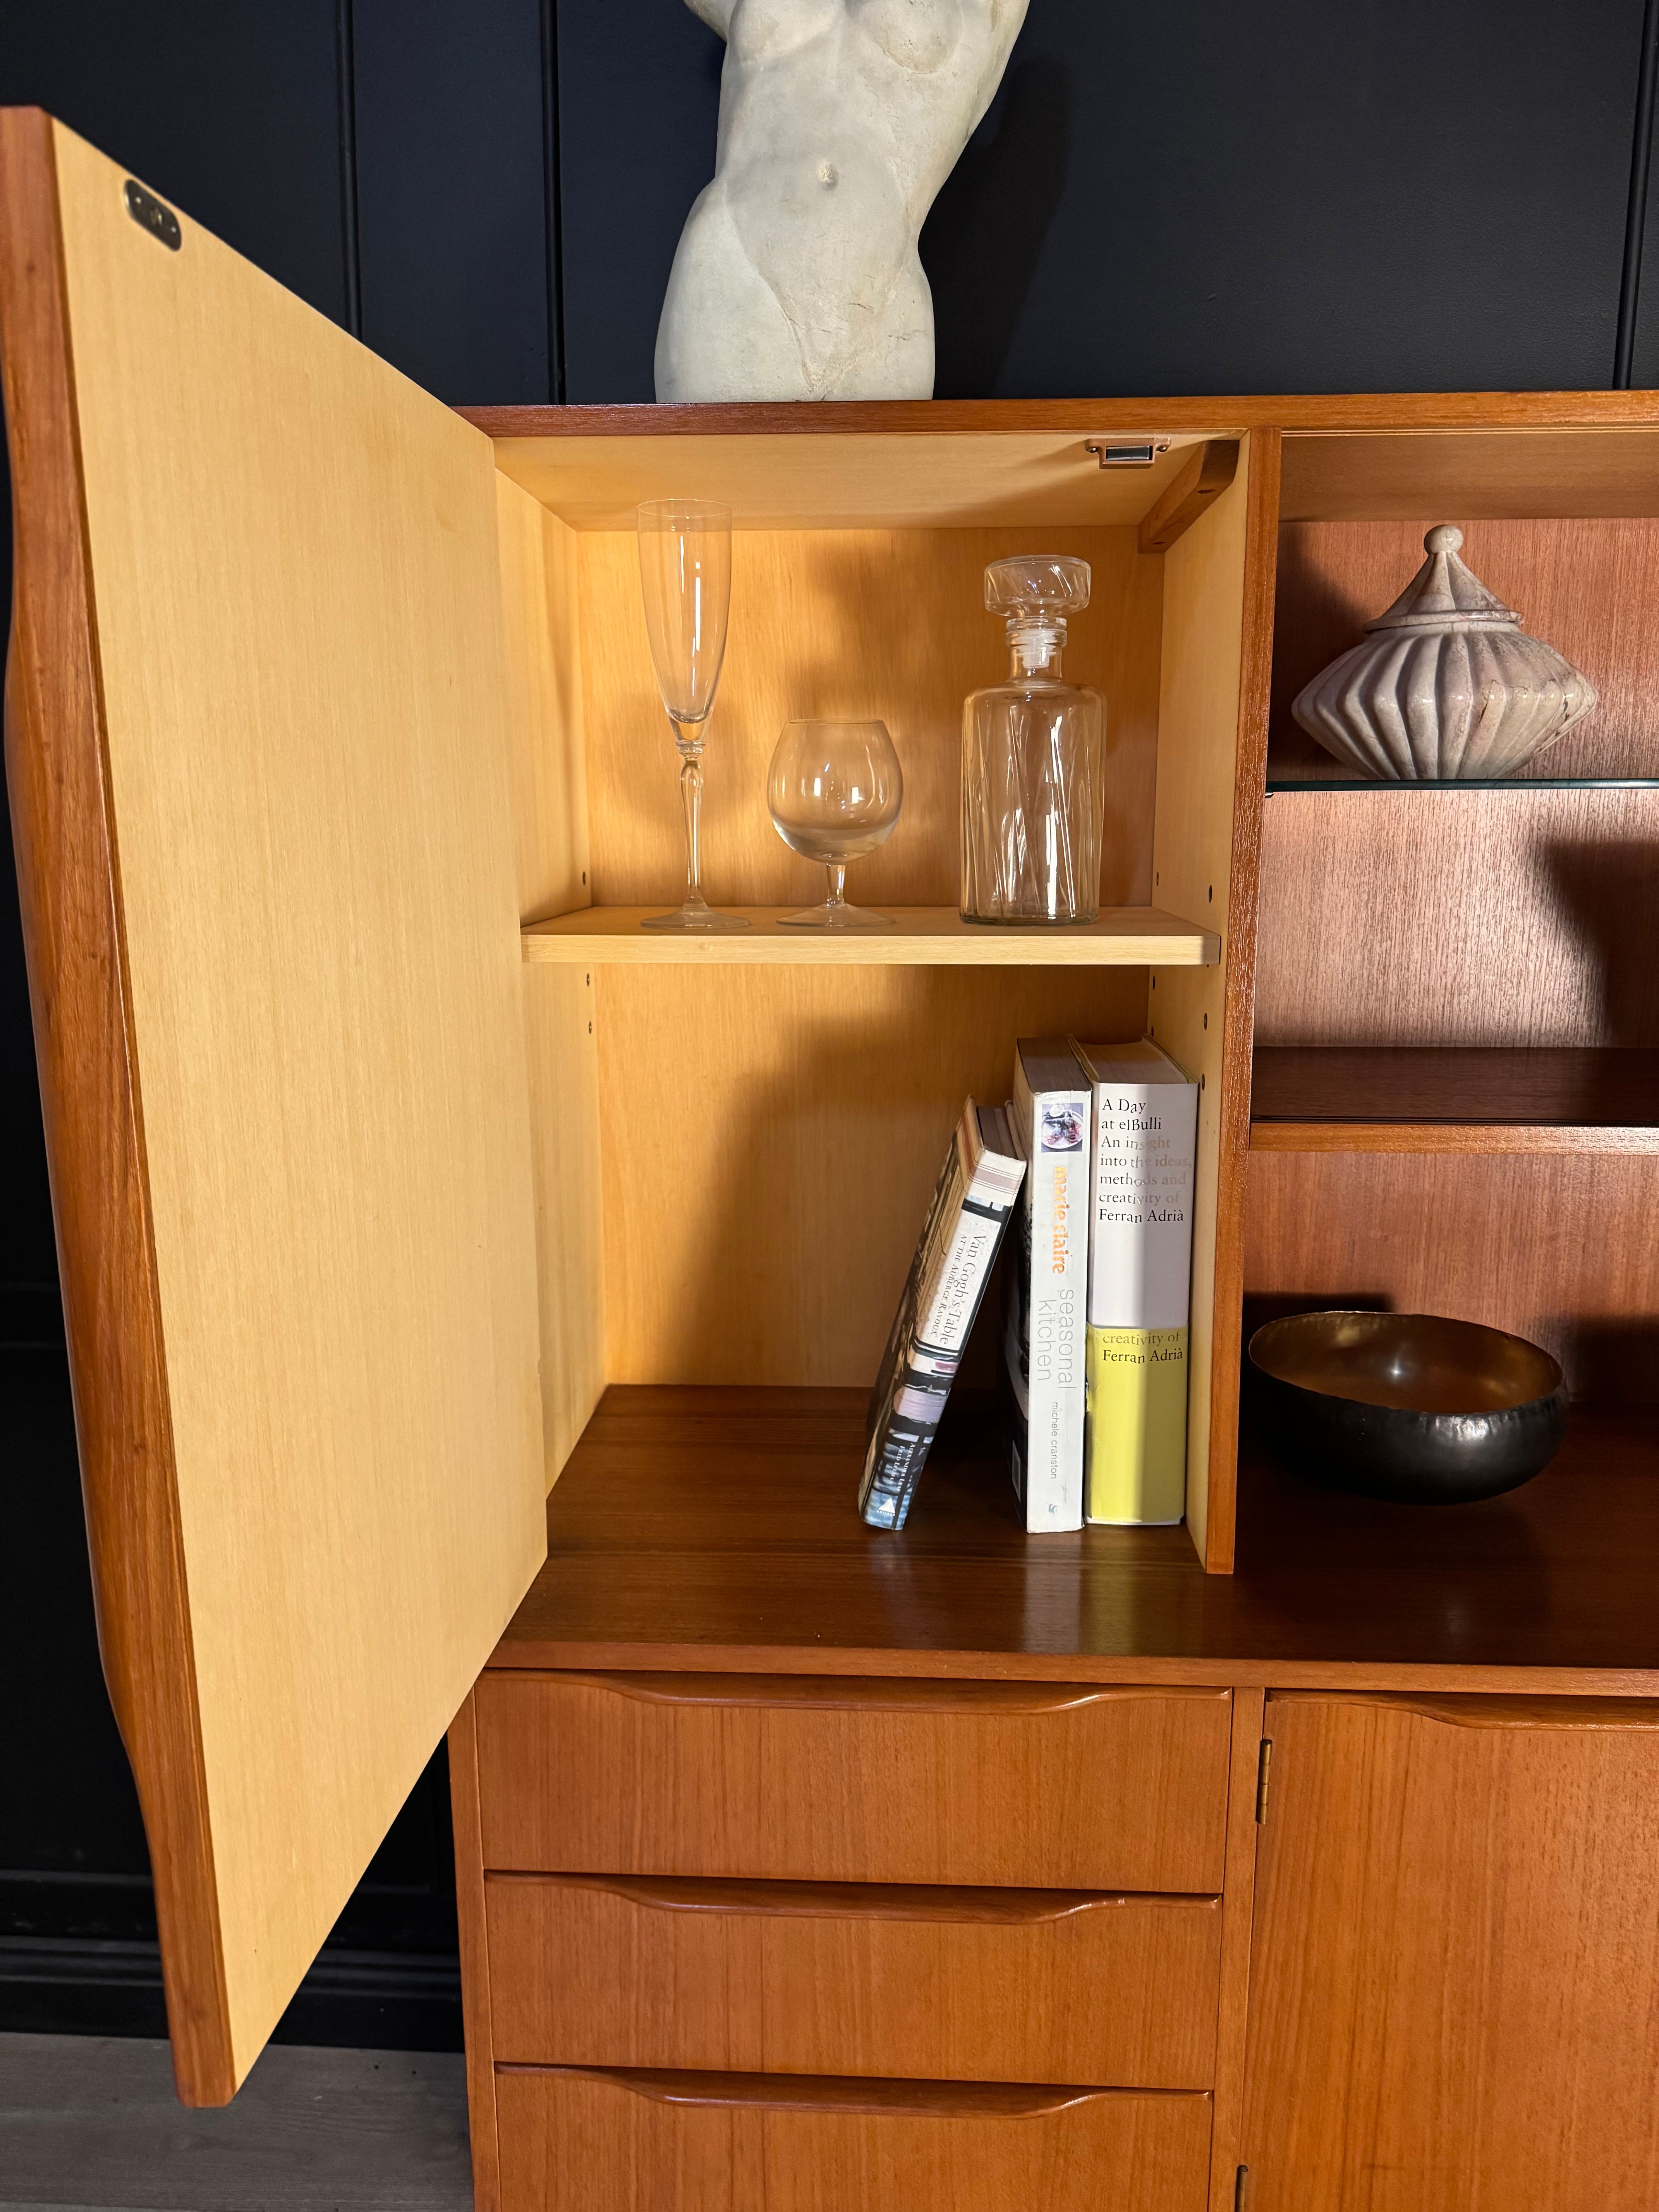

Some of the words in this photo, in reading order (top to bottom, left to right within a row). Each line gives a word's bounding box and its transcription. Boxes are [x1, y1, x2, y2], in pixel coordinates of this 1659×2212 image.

[1102, 1099, 1113, 1110] A
[1119, 1099, 1146, 1114] Day
[1101, 1120, 1115, 1129] at
[1119, 1117, 1161, 1131] elBulli
[1101, 1136, 1120, 1147] An
[1126, 1136, 1170, 1151] insight
[1101, 1154, 1127, 1166] into
[1131, 1156, 1151, 1168] the
[1155, 1154, 1192, 1168] ideas,
[1100, 1173, 1157, 1187] methods
[1162, 1173, 1186, 1185] and
[1053, 1167, 1070, 1220] marie
[1099, 1192, 1161, 1206] creativity
[1166, 1190, 1180, 1204] of
[1099, 1209, 1142, 1223] Ferran
[1147, 1209, 1184, 1222] Adrià
[968, 1235, 986, 1258] Van
[1052, 1224, 1069, 1274] claire
[940, 1311, 962, 1345] Table
[1037, 1300, 1056, 1380] kitchen
[1058, 1289, 1077, 1389] seasonal
[1103, 1332, 1163, 1346] creativity
[1168, 1330, 1181, 1342] of
[1103, 1350, 1145, 1364] Ferran
[1149, 1348, 1183, 1362] Adrià
[1051, 1402, 1059, 1436] michele
